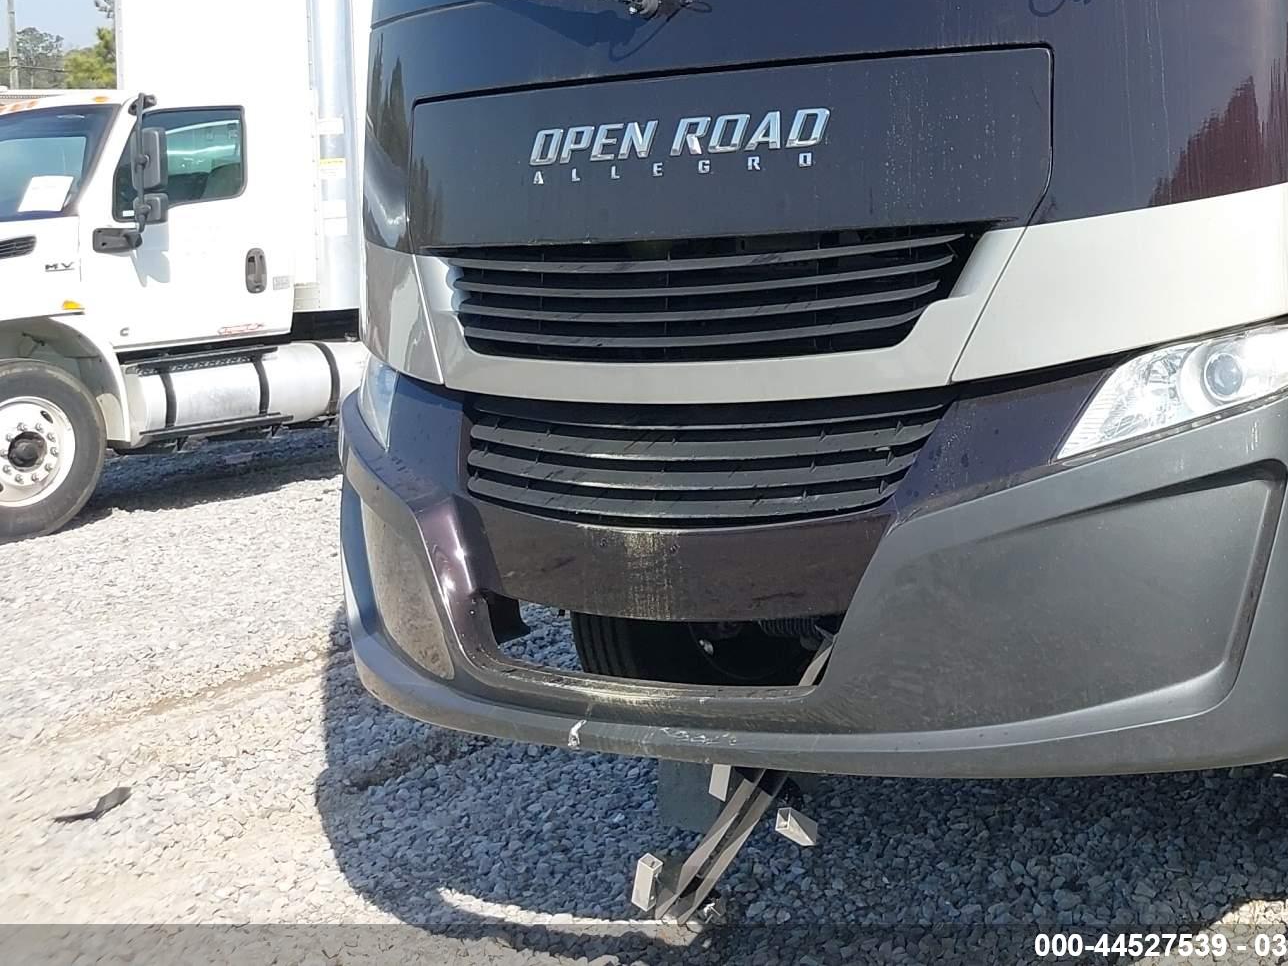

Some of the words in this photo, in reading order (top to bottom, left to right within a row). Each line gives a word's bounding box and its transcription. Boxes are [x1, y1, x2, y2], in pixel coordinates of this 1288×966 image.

[529, 120, 659, 166] OPEN
[669, 107, 831, 157] ROAD
[532, 152, 813, 185] ALLEGRO
